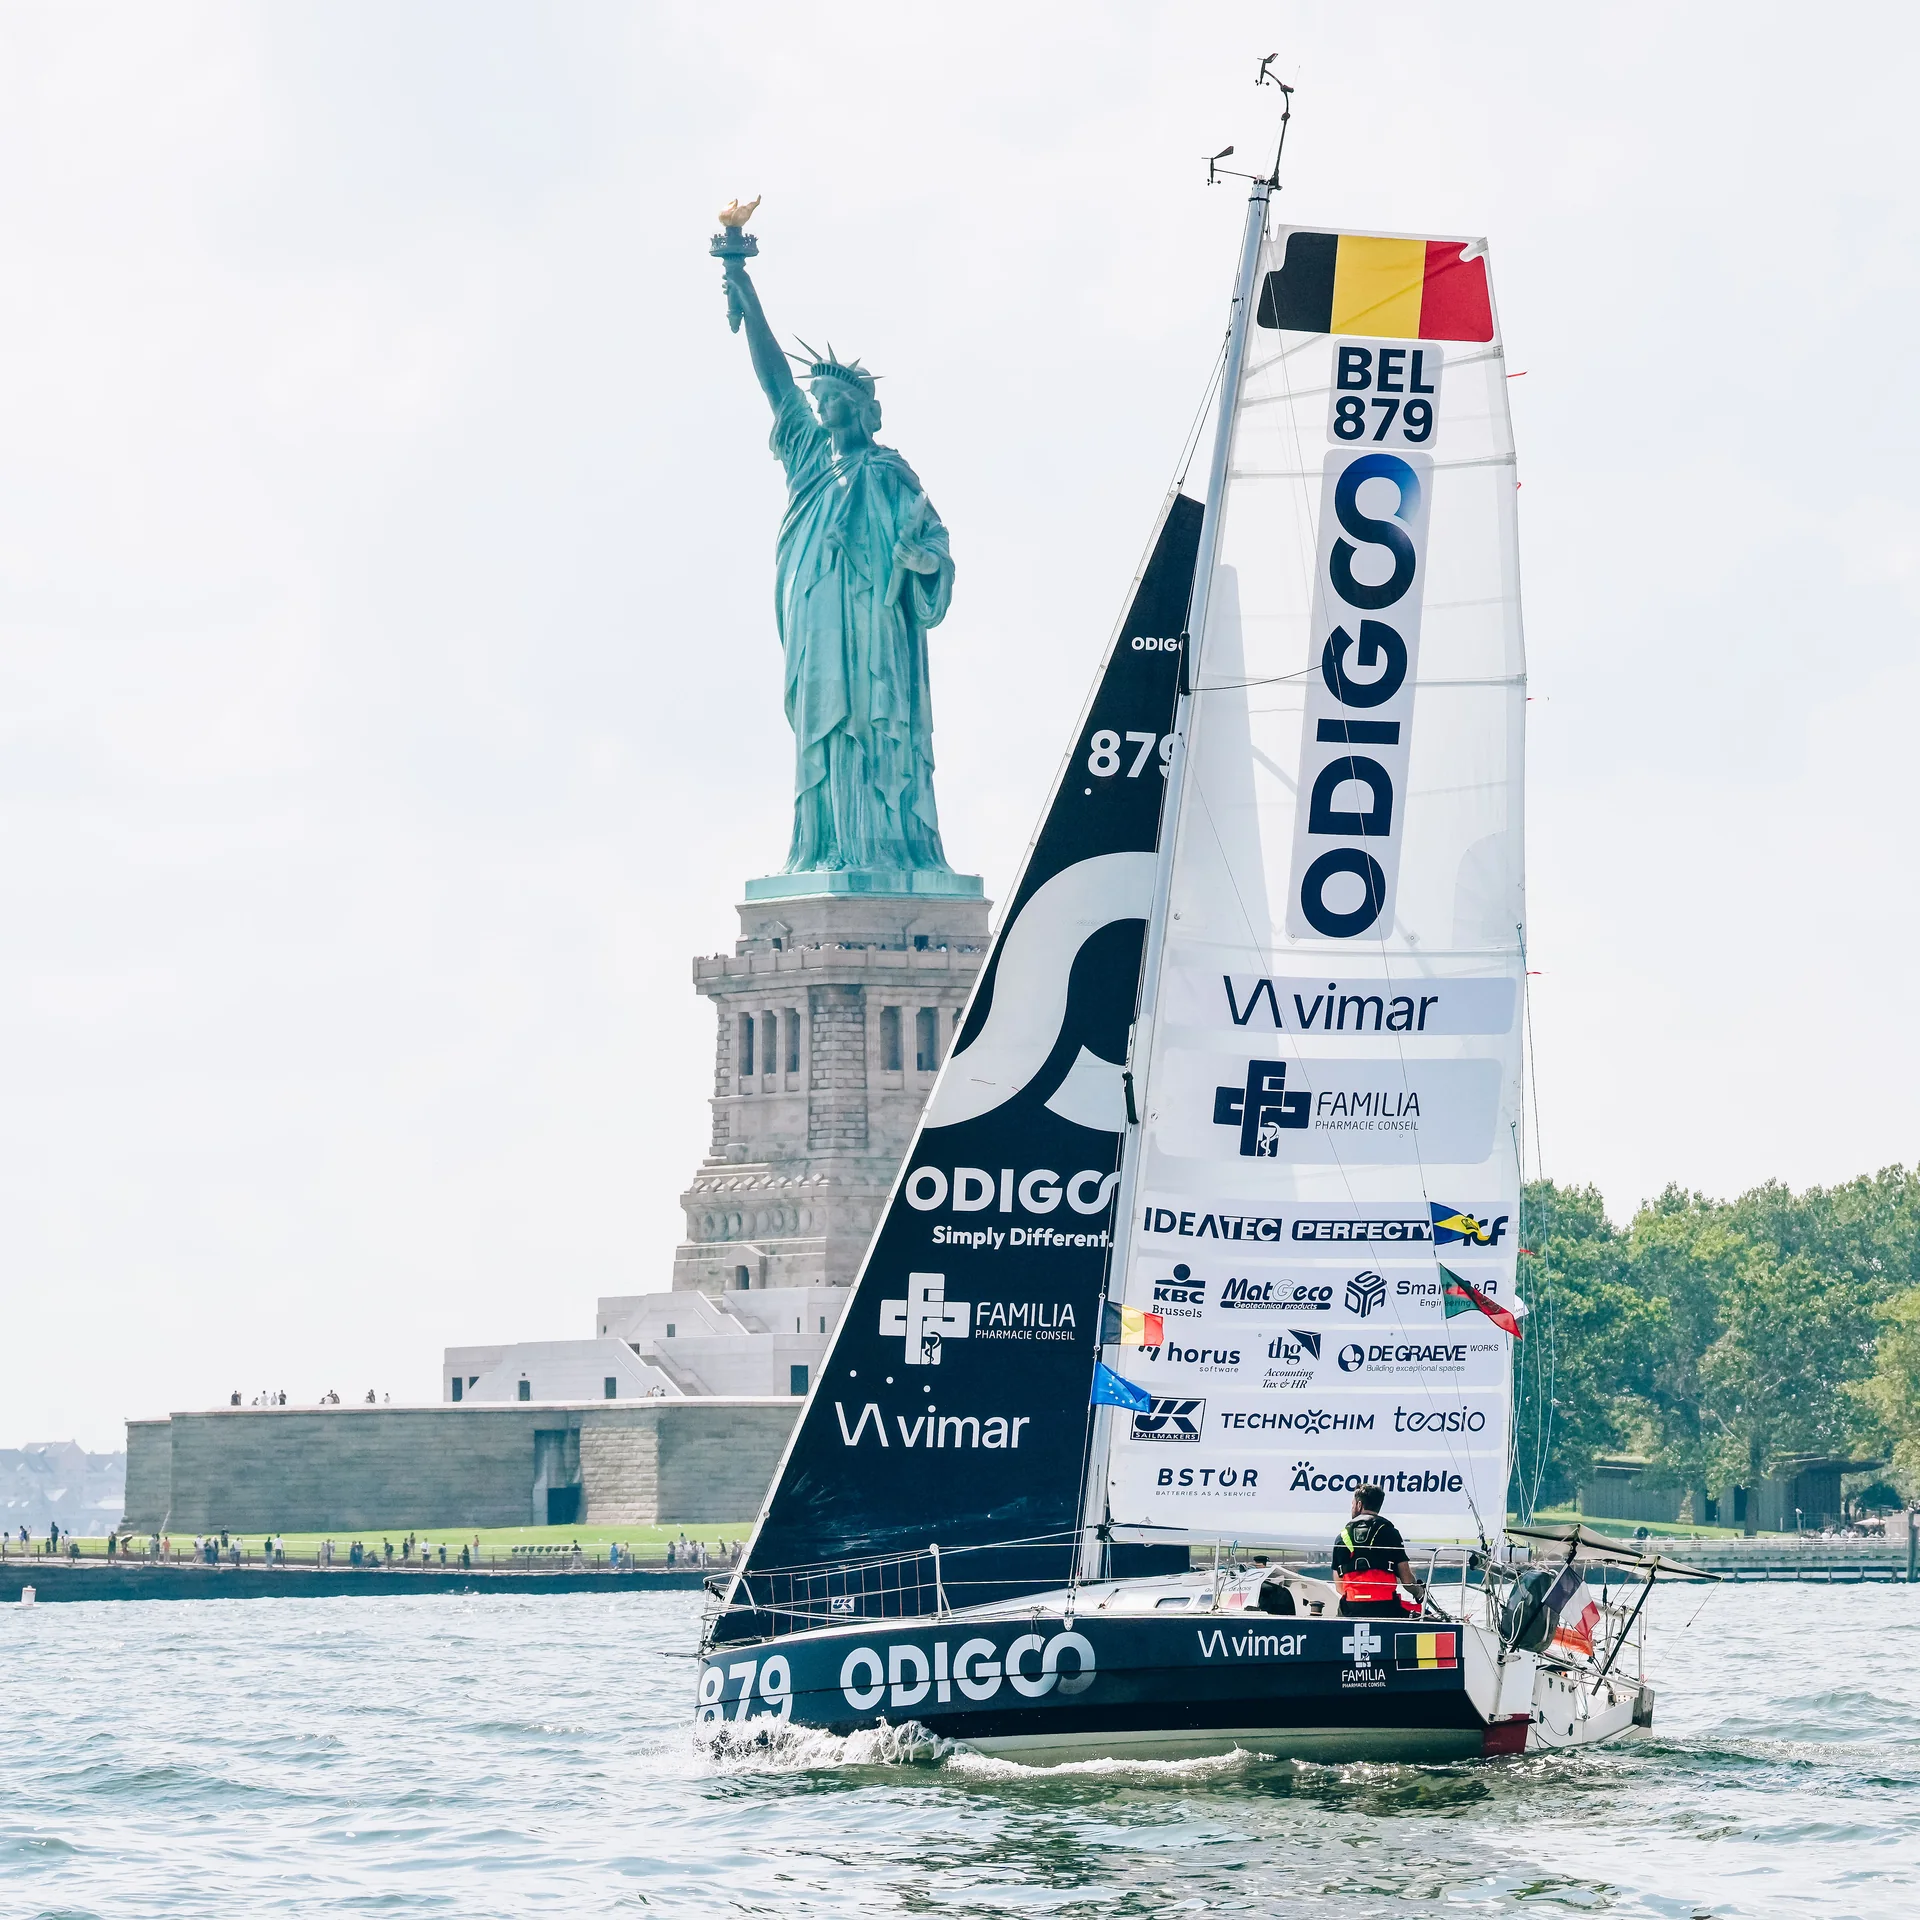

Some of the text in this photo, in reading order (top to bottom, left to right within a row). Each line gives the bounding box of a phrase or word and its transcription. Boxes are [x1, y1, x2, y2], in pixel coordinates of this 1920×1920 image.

[1336, 346, 1435, 394] BEL
[1333, 396, 1433, 443] 879
[1131, 636, 1183, 652] ODIG
[1293, 982, 1439, 1032] vimar
[1316, 1091, 1421, 1117] FAMILIA
[1315, 1120, 1419, 1131] PHARMACIE CONSEIL
[1143, 1206, 1282, 1242] IDEATEC
[1297, 1221, 1433, 1240] PERFECTY
[932, 1225, 1114, 1250] Simply Different.
[1153, 1286, 1205, 1304] KBC
[1221, 1277, 1333, 1301] MatGeco
[976, 1302, 1076, 1328] FAMILIA
[1152, 1304, 1202, 1318] Brussels
[1233, 1301, 1317, 1311] Geotechnical products
[975, 1329, 1075, 1341] PHARMACIE CONSEIL
[1167, 1342, 1241, 1364] horus
[1268, 1336, 1301, 1366] thg
[1368, 1344, 1499, 1361] DE GRAEVE WORKS
[1199, 1365, 1239, 1373] software
[1264, 1367, 1314, 1380] Accounting
[1366, 1364, 1465, 1373] Building exceptional spaces
[1262, 1378, 1308, 1389] Tax & HR
[896, 1405, 1030, 1448] vimar
[1394, 1406, 1485, 1432] teasio
[1134, 1432, 1197, 1441] SAILMAKERS
[1289, 1464, 1463, 1492] Accountable
[1231, 1629, 1306, 1657] vimar
[1342, 1668, 1386, 1682] FAMILIA
[697, 1655, 794, 1724] 879
